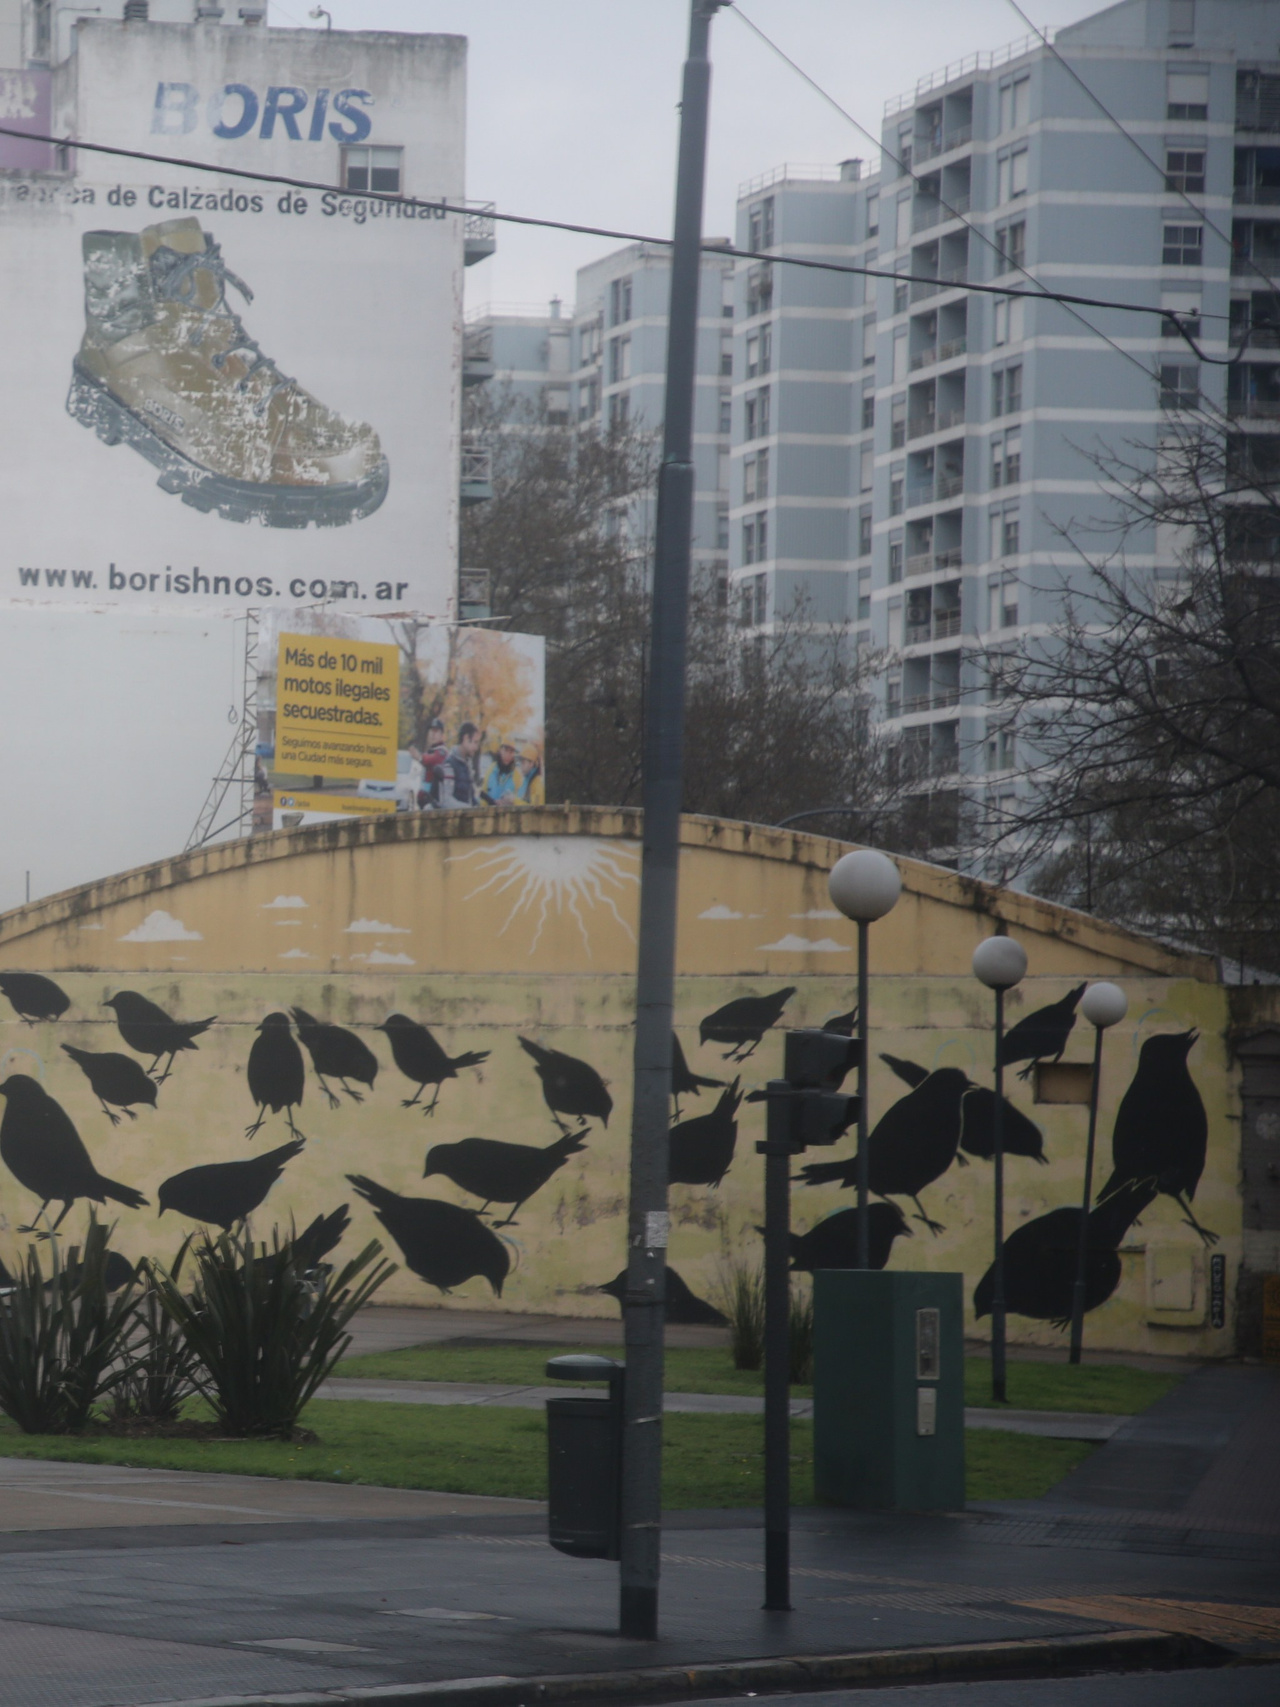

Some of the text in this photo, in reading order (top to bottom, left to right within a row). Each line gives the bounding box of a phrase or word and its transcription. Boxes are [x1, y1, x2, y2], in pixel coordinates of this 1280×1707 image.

[150, 81, 375, 142] BORIS
[107, 184, 137, 207] de
[148, 184, 263, 213] Calzados
[277, 191, 308, 215] de
[320, 191, 447, 224] Seguridad
[285, 647, 383, 675] Más de 10 mil
[284, 677, 391, 702] motos ilegales
[283, 703, 383, 726] secuestradas.
[281, 736, 322, 749] Seguimos
[322, 741, 365, 753] avanzando
[281, 752, 297, 760] una
[298, 751, 326, 763] Ciudad
[327, 754, 344, 765] más
